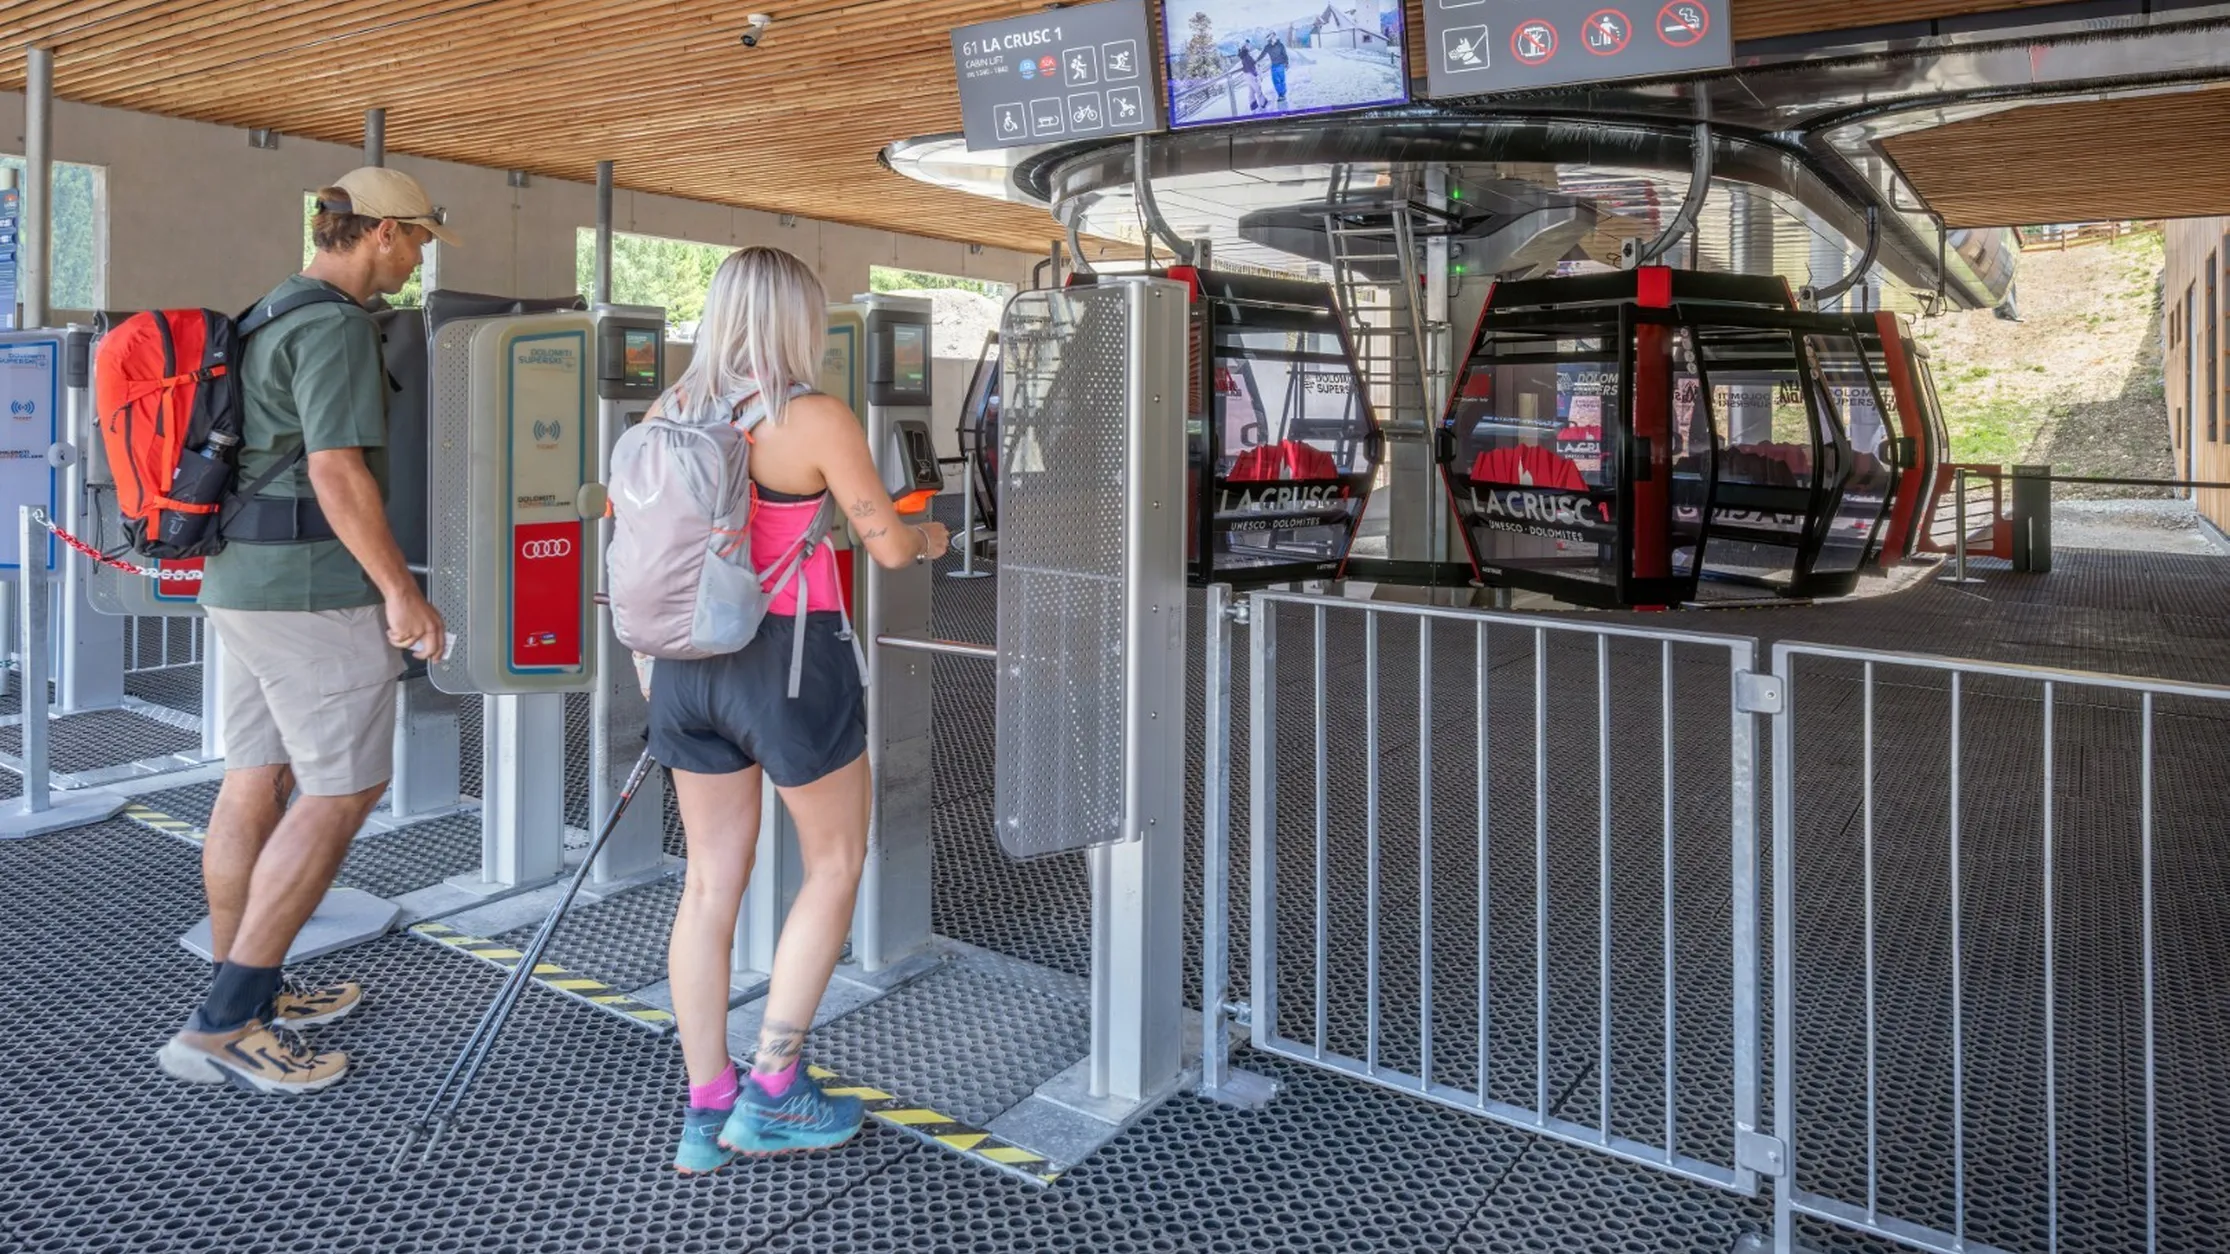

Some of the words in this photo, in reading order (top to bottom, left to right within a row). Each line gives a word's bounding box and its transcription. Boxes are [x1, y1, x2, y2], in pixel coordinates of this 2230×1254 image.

[963, 41, 978, 56] 61
[982, 37, 1002, 53] LA
[1004, 28, 1052, 49] CRUSC
[1054, 26, 1062, 41] 1
[965, 57, 988, 69] CABIN
[989, 55, 1005, 66] LIFT
[1315, 373, 1350, 384] DOLOM
[1577, 372, 1620, 384] DOLOM
[1316, 383, 1350, 394] SUPERS
[1573, 384, 1619, 396] SUPERS
[1219, 487, 1254, 515] LA
[1258, 484, 1339, 514] CRUSC
[1341, 485, 1350, 504] 1
[1470, 486, 1505, 517] LA
[1506, 490, 1596, 528] CRUSC
[1598, 501, 1610, 523] 1
[1230, 519, 1267, 532] UNESCO
[1272, 516, 1321, 529] DOLOMITES
[1488, 519, 1524, 534] UNESCO
[1529, 525, 1585, 543] DOLOMITES
